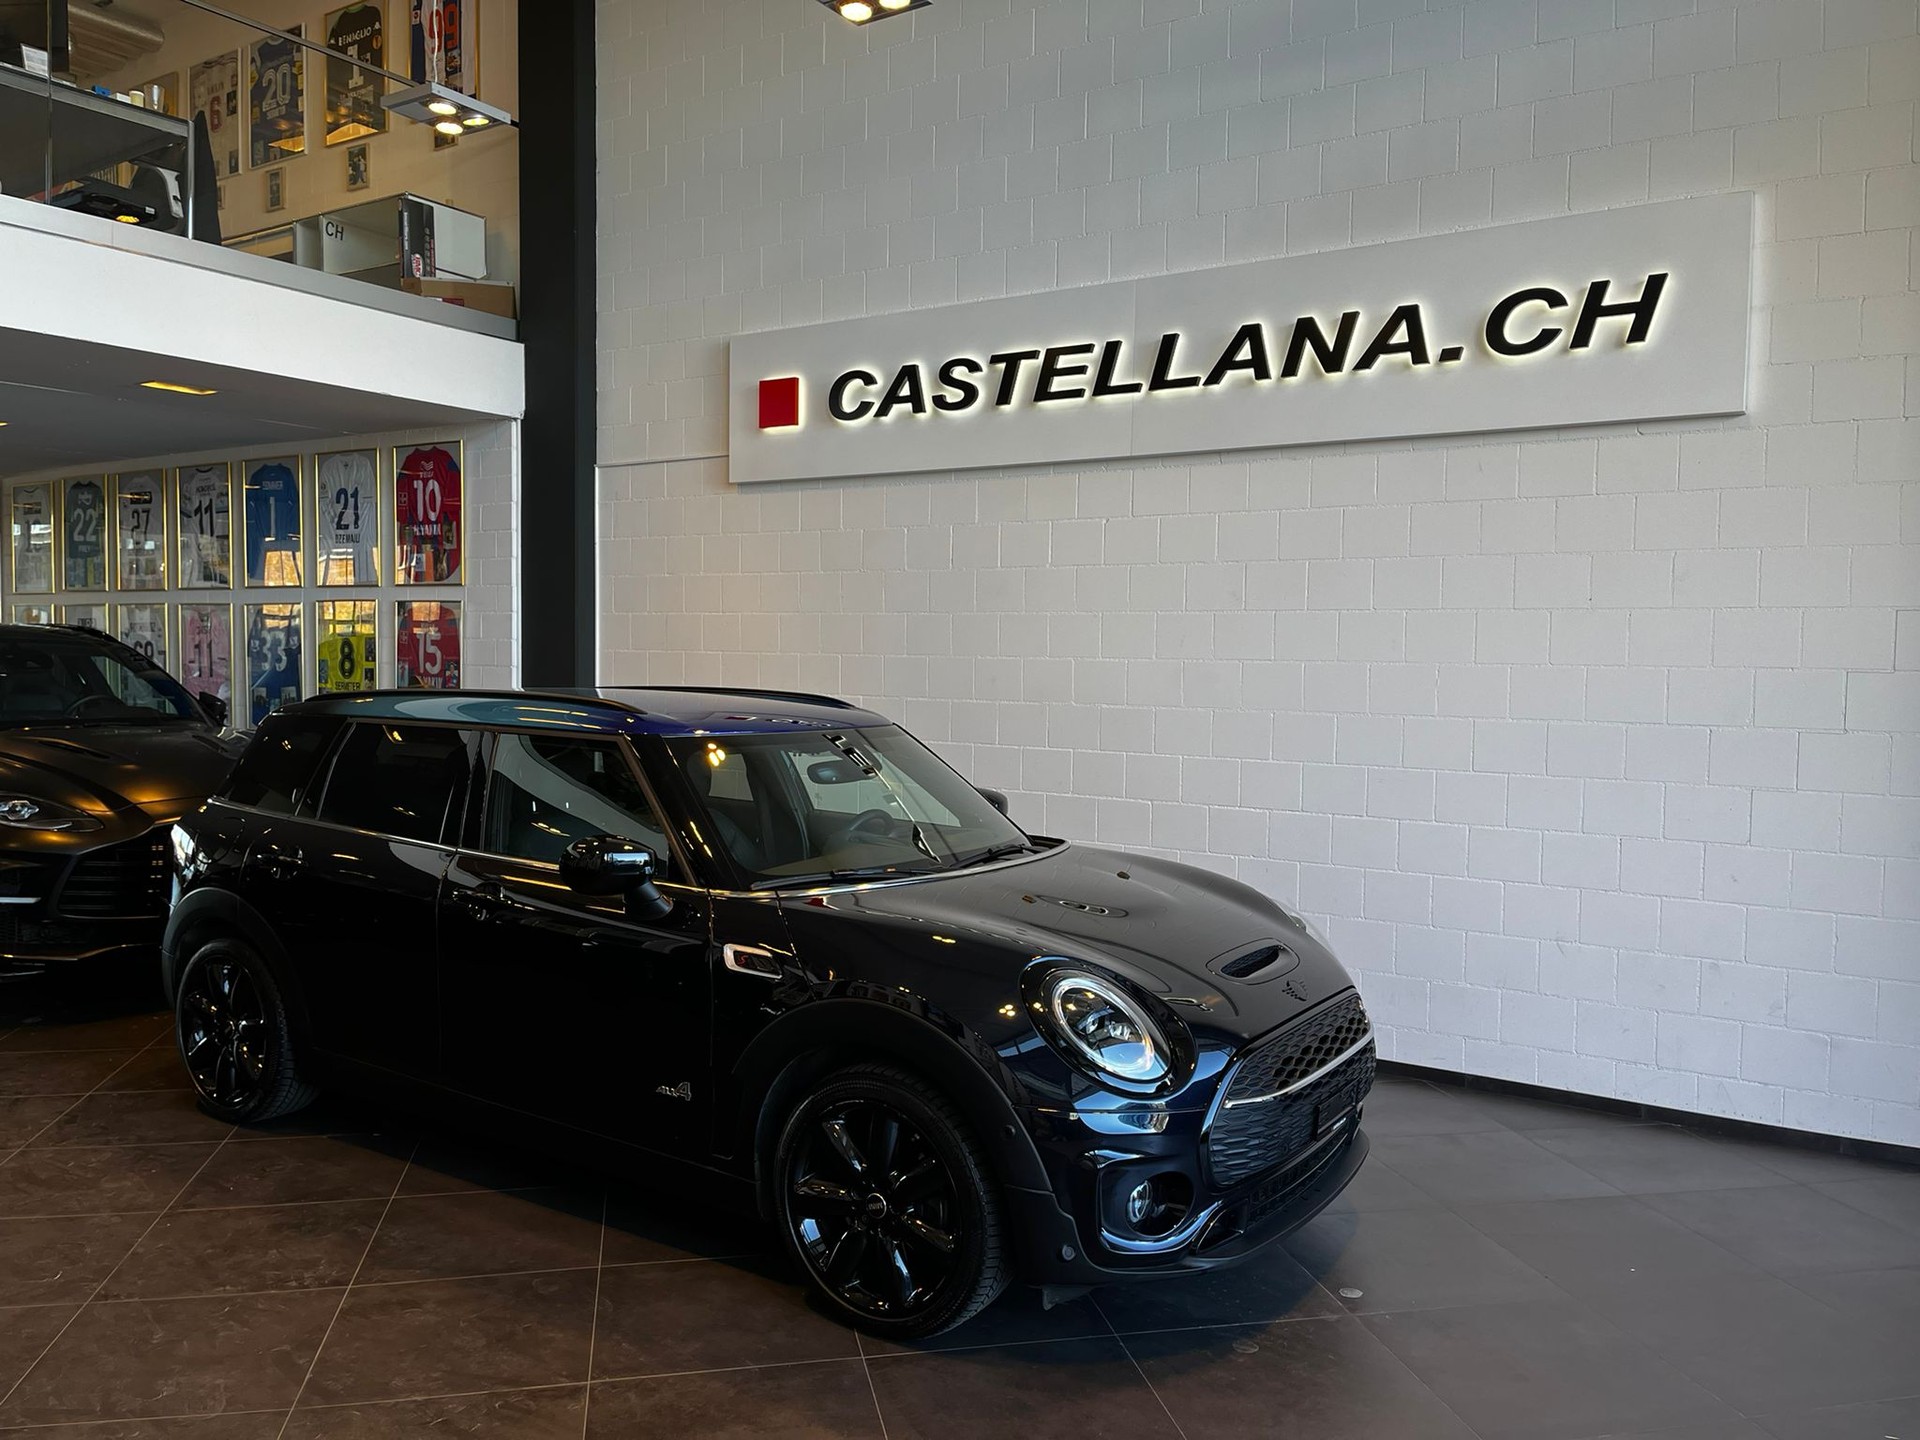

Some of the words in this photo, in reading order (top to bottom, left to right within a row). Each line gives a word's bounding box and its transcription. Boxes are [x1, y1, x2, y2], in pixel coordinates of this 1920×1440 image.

[338, 26, 372, 47] BENAGLIO
[262, 63, 291, 112] 20
[347, 44, 364, 89] 1
[325, 221, 344, 241] CH
[829, 272, 1668, 421] CASTELLANA.CH
[194, 498, 215, 537] 11
[335, 486, 360, 531] 21
[413, 479, 442, 522] 10
[73, 508, 97, 542] 22
[131, 508, 151, 545] 27
[194, 639, 213, 678] 11
[261, 630, 288, 672] 33
[339, 637, 356, 679] 8
[416, 631, 442, 675] 15
